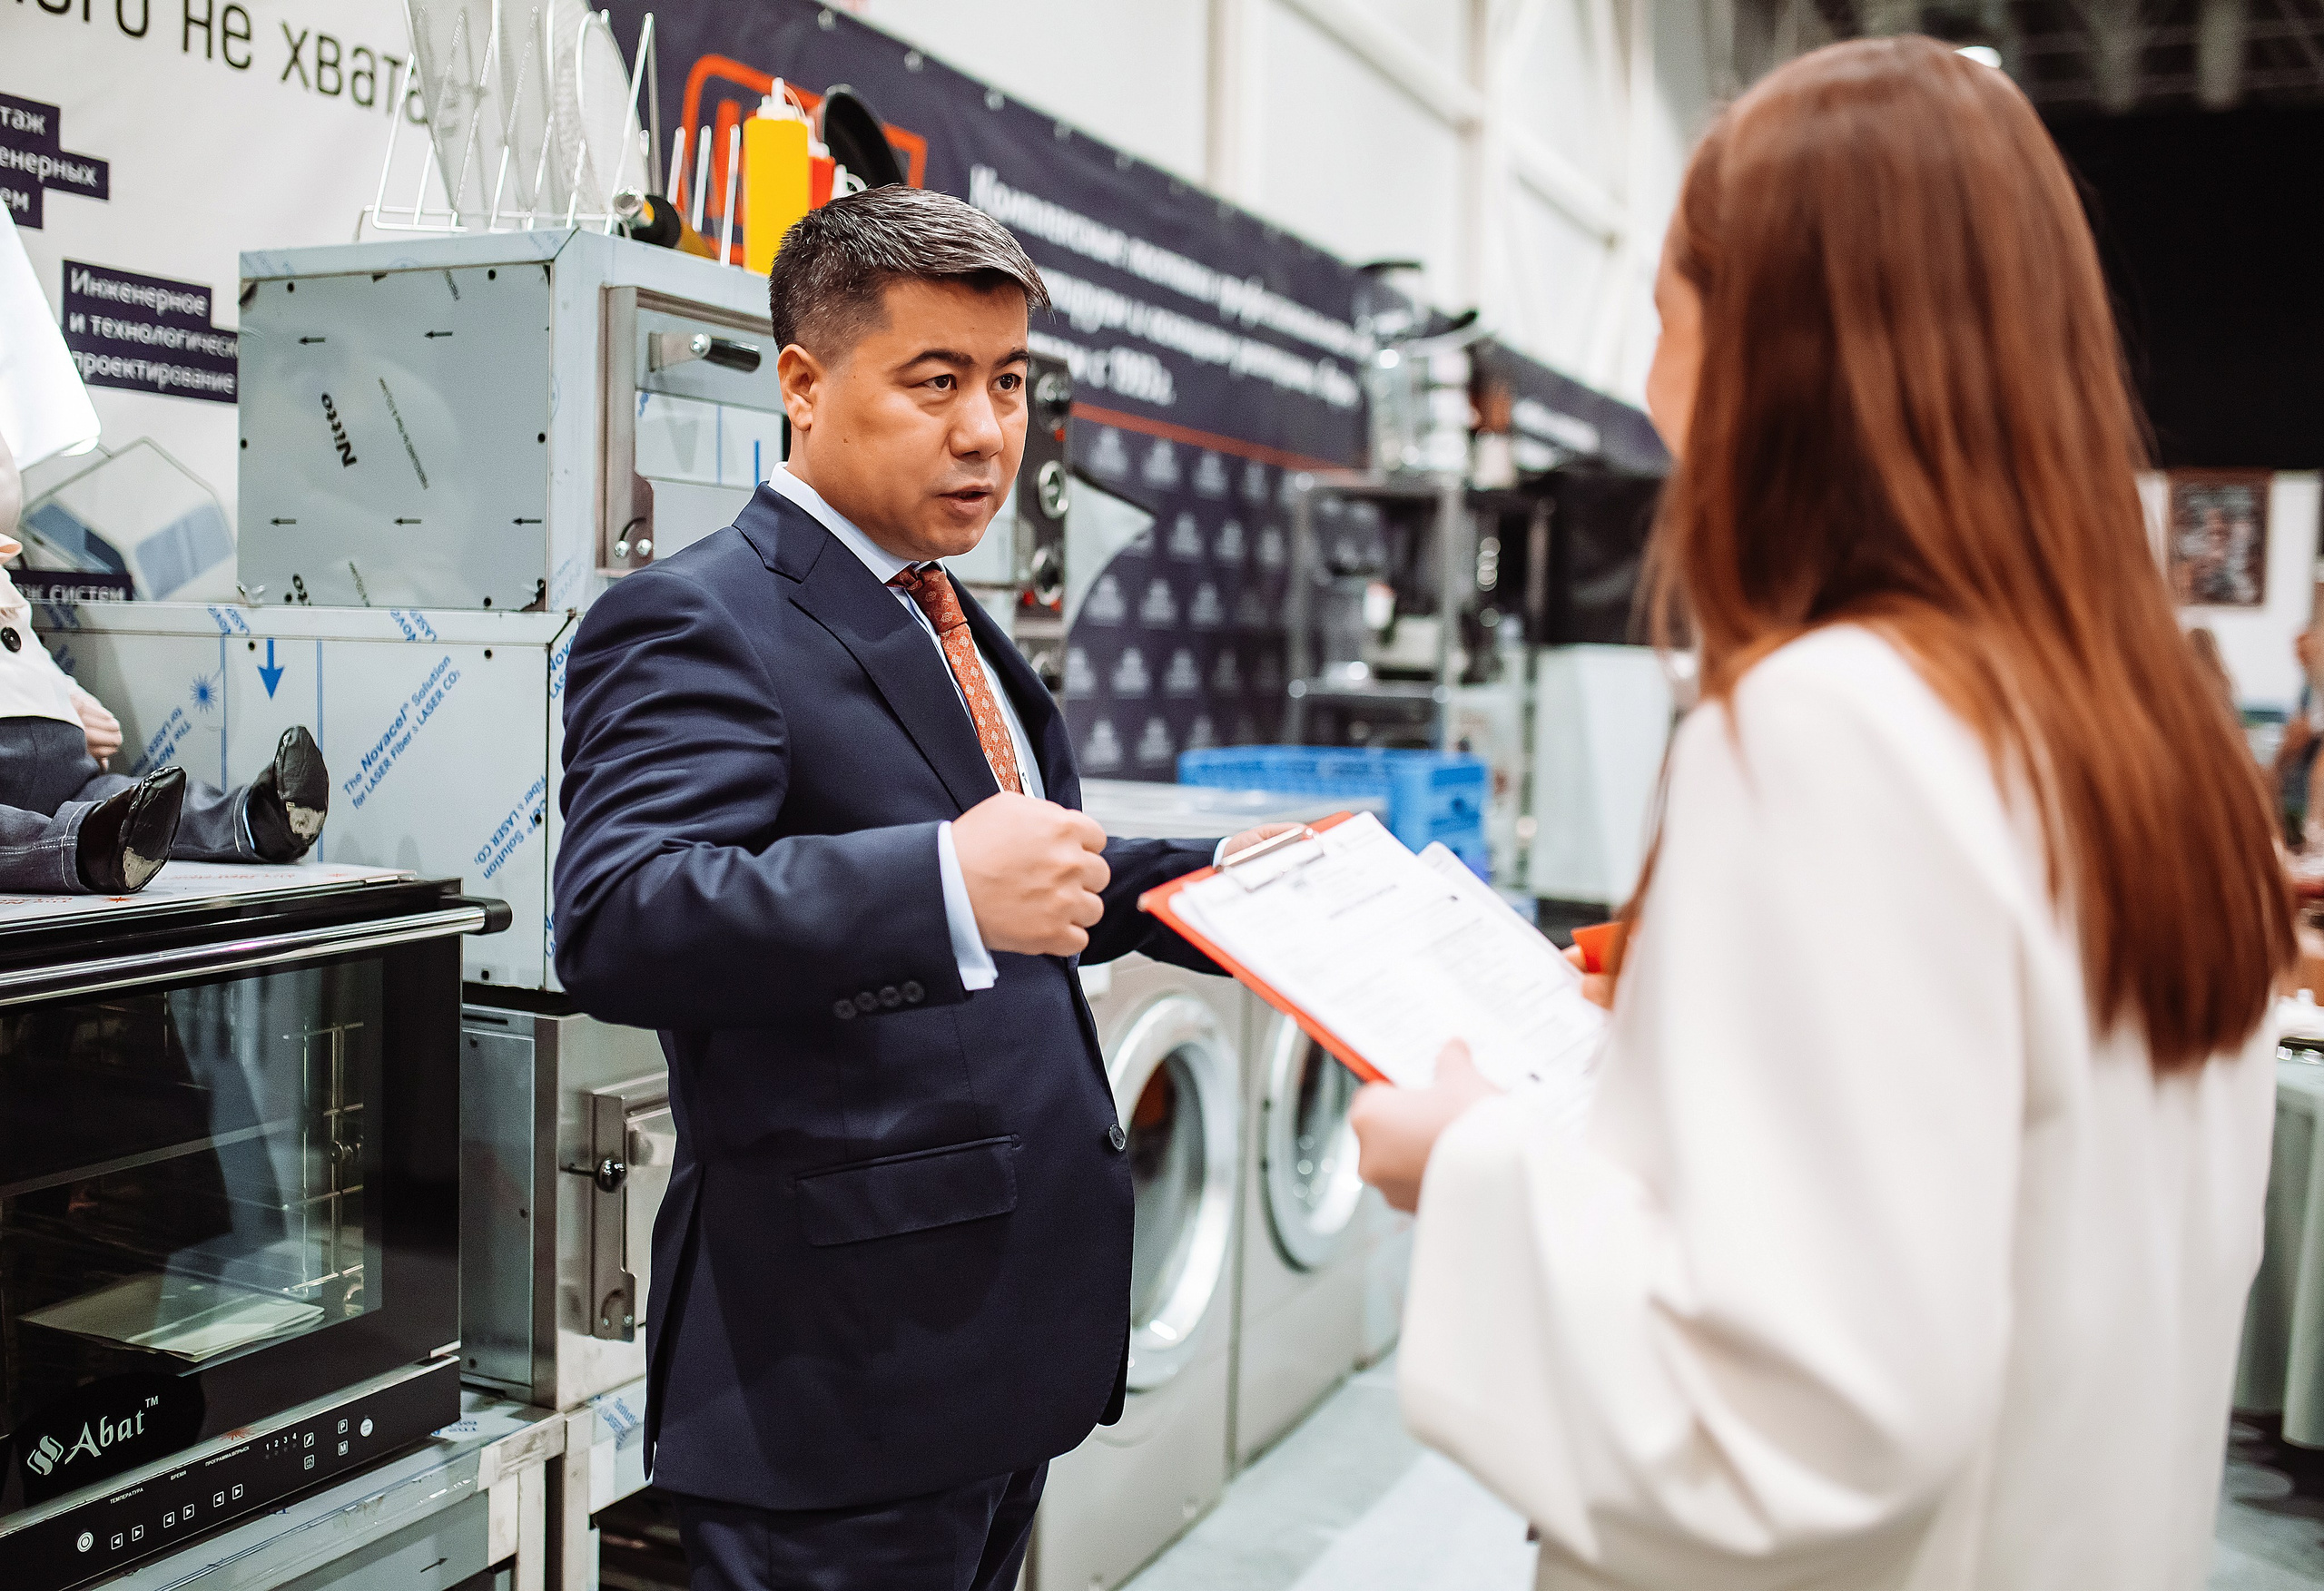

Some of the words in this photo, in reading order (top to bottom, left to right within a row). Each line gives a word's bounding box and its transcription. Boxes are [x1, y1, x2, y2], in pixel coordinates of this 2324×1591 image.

[182, 0, 253, 71] не
[69, 311, 86, 334] и
[320, 391, 358, 468] Nitto
[342, 771, 362, 795] The
[411, 654, 451, 706] Solution
[352, 791, 367, 810] for
[364, 757, 393, 793] LASER
[389, 731, 412, 761] Fiber
[416, 688, 446, 726] LASER
[483, 830, 525, 879] Solution
[491, 810, 519, 848] LASER
[64, 1409, 145, 1465] Abat
